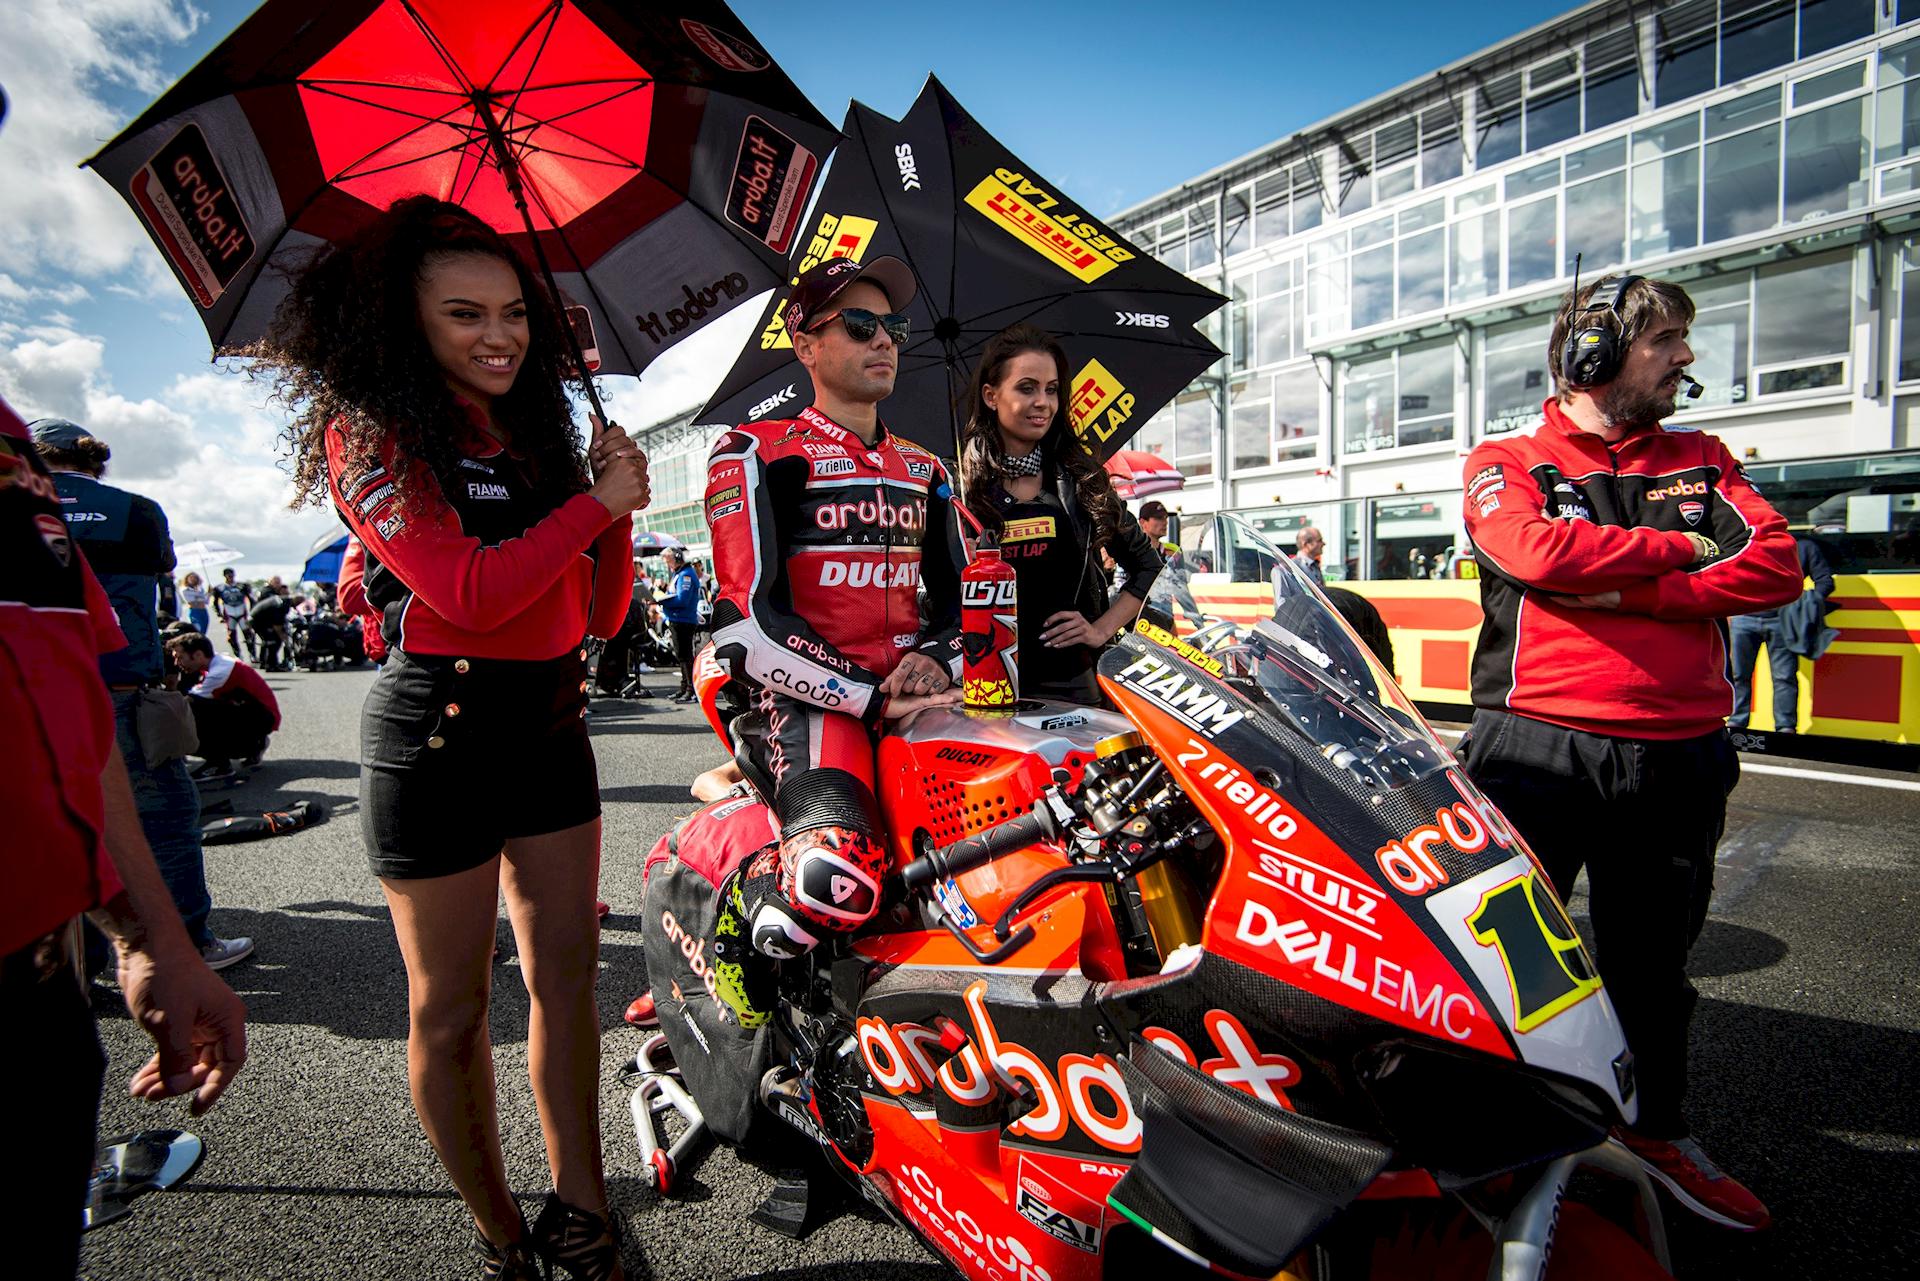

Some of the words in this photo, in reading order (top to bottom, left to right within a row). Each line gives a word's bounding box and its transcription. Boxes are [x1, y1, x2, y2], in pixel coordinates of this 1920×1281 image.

[742, 134, 778, 225] aruba.it
[895, 142, 920, 191] SBK
[994, 167, 1060, 206] LAP
[175, 156, 245, 260] aruba.it
[791, 212, 840, 286] BES
[987, 193, 1099, 269] PIRELLI
[1052, 214, 1135, 263] BEST
[1116, 311, 1169, 329] SBK
[748, 383, 797, 421] SBK
[1093, 393, 1136, 442] LAP
[800, 407, 847, 442] DUCATI
[802, 443, 848, 457] FIAMM
[825, 459, 855, 473] riello
[468, 483, 508, 497] FIAMM
[1558, 503, 1589, 518] FIAMM
[1646, 479, 1707, 500] aruba
[787, 634, 853, 673] aruba.it
[1120, 654, 1244, 734] FIAMM
[935, 747, 998, 768] DUCATI
[1198, 762, 1298, 840] riello
[1258, 852, 1379, 926] STULZ
[897, 1178, 985, 1270] DUCATI
[1020, 1209, 1053, 1233] Auto
[1053, 1228, 1096, 1252] Parts
